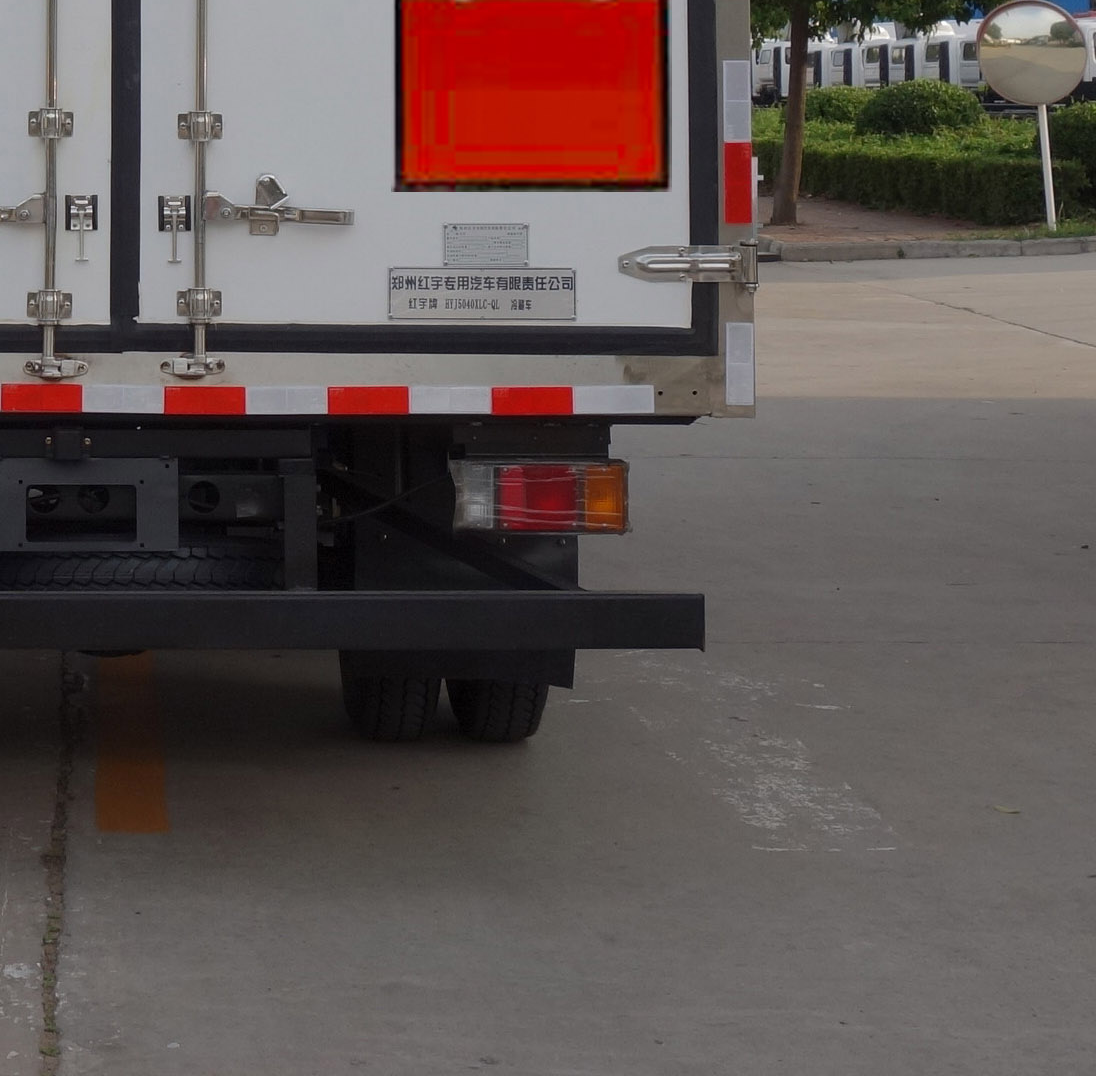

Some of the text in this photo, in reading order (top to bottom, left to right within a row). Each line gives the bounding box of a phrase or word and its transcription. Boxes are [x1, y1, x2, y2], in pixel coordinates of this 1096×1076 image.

[391, 276, 574, 291] 郑州红宇专用汽车有限责任公司
[408, 298, 438, 310] 红宇牌
